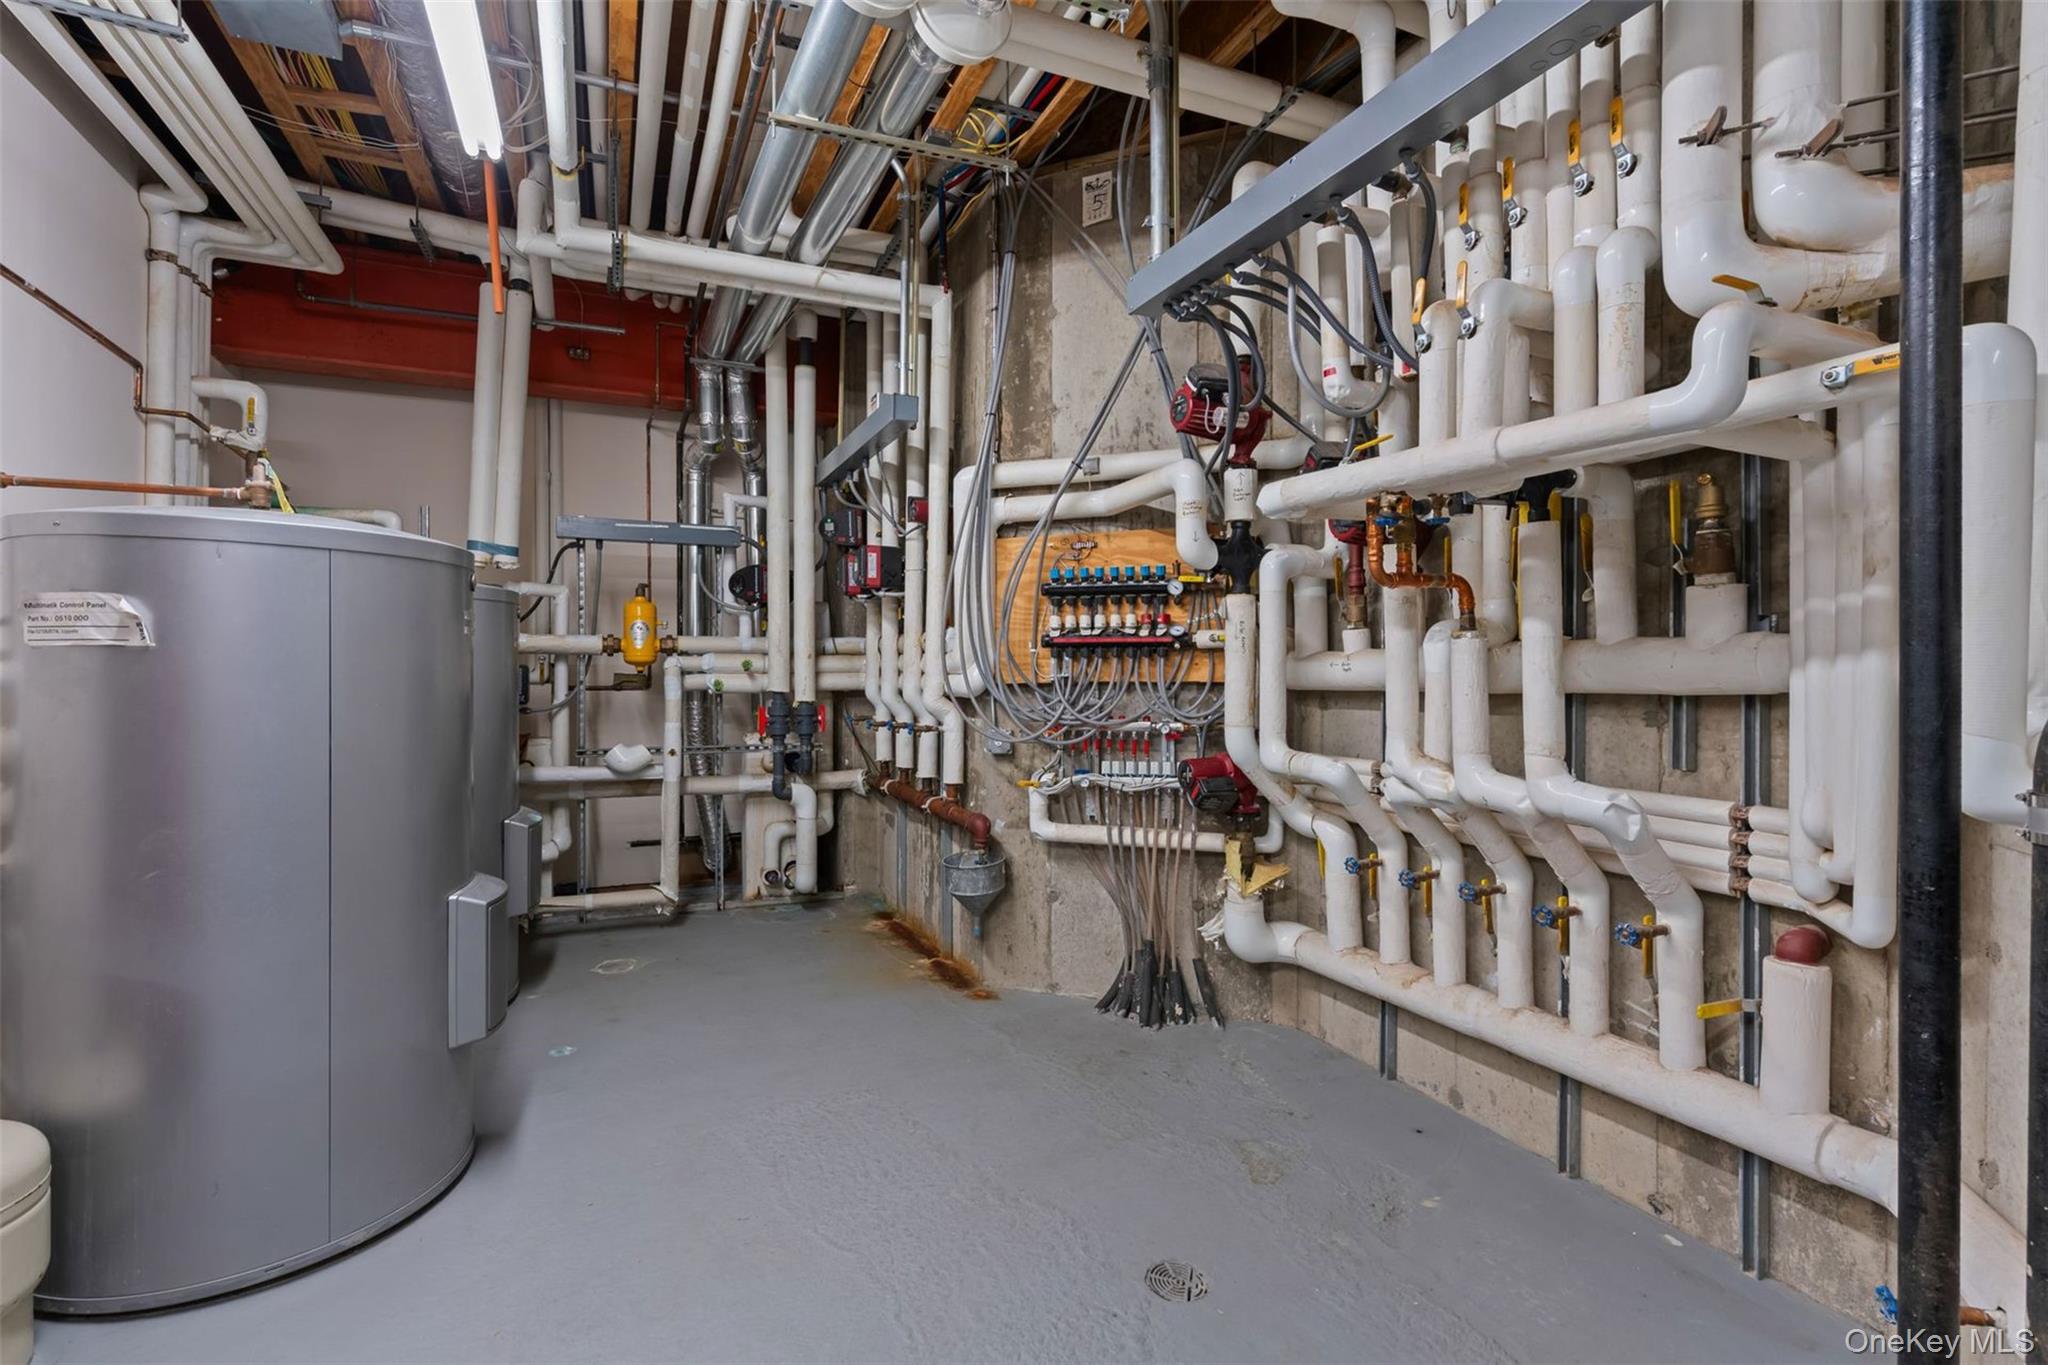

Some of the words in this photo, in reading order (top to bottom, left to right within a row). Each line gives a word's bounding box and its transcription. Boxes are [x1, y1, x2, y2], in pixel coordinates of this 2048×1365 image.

[59, 601, 84, 609] Control
[86, 601, 107, 609] Panel
[27, 614, 39, 622] Part
